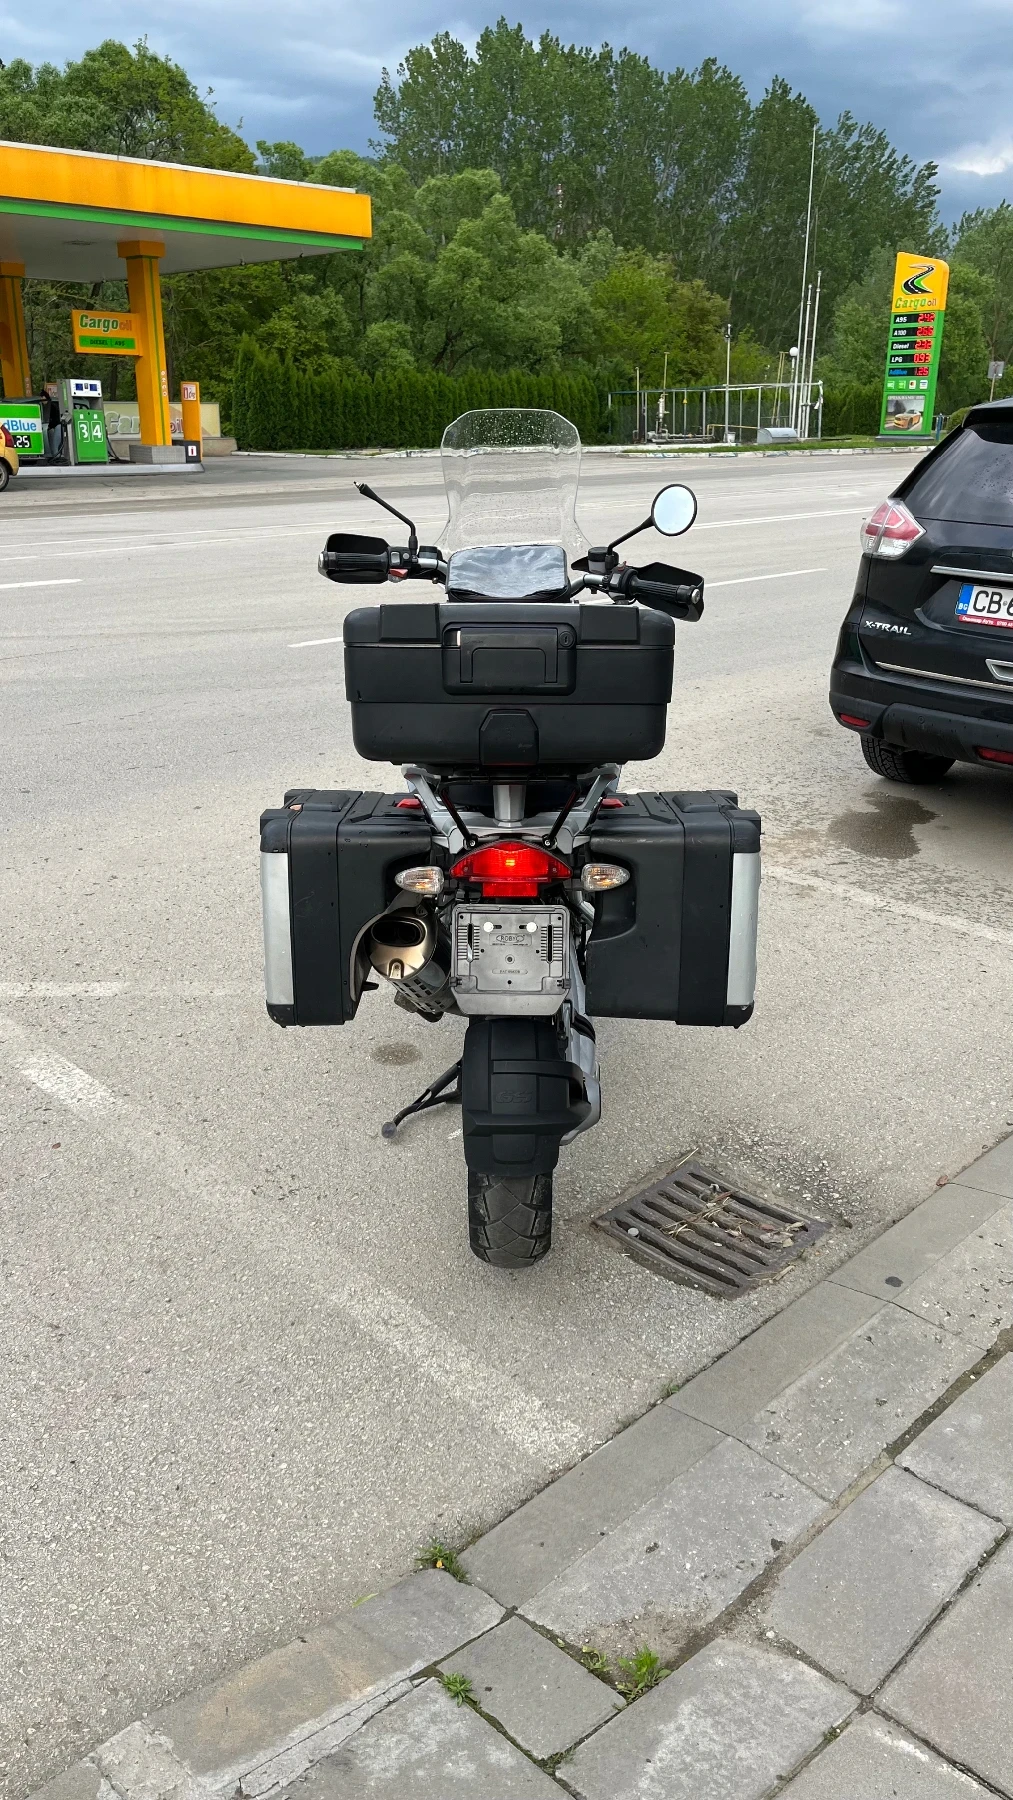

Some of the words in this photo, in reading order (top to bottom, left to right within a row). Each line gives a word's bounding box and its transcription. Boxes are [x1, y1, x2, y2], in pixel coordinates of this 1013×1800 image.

[895, 297, 926, 310] Cargo
[927, 298, 937, 306] oil
[79, 313, 119, 333] Cargo
[119, 319, 132, 331] oil
[914, 367, 929, 375] 1.25
[3, 419, 37, 431] dBlue
[79, 423, 89, 439] 3
[93, 423, 102, 439] 4
[13, 435, 30, 448] .25
[864, 620, 912, 635] X-TRAIL
[495, 1091, 533, 1104] GS
